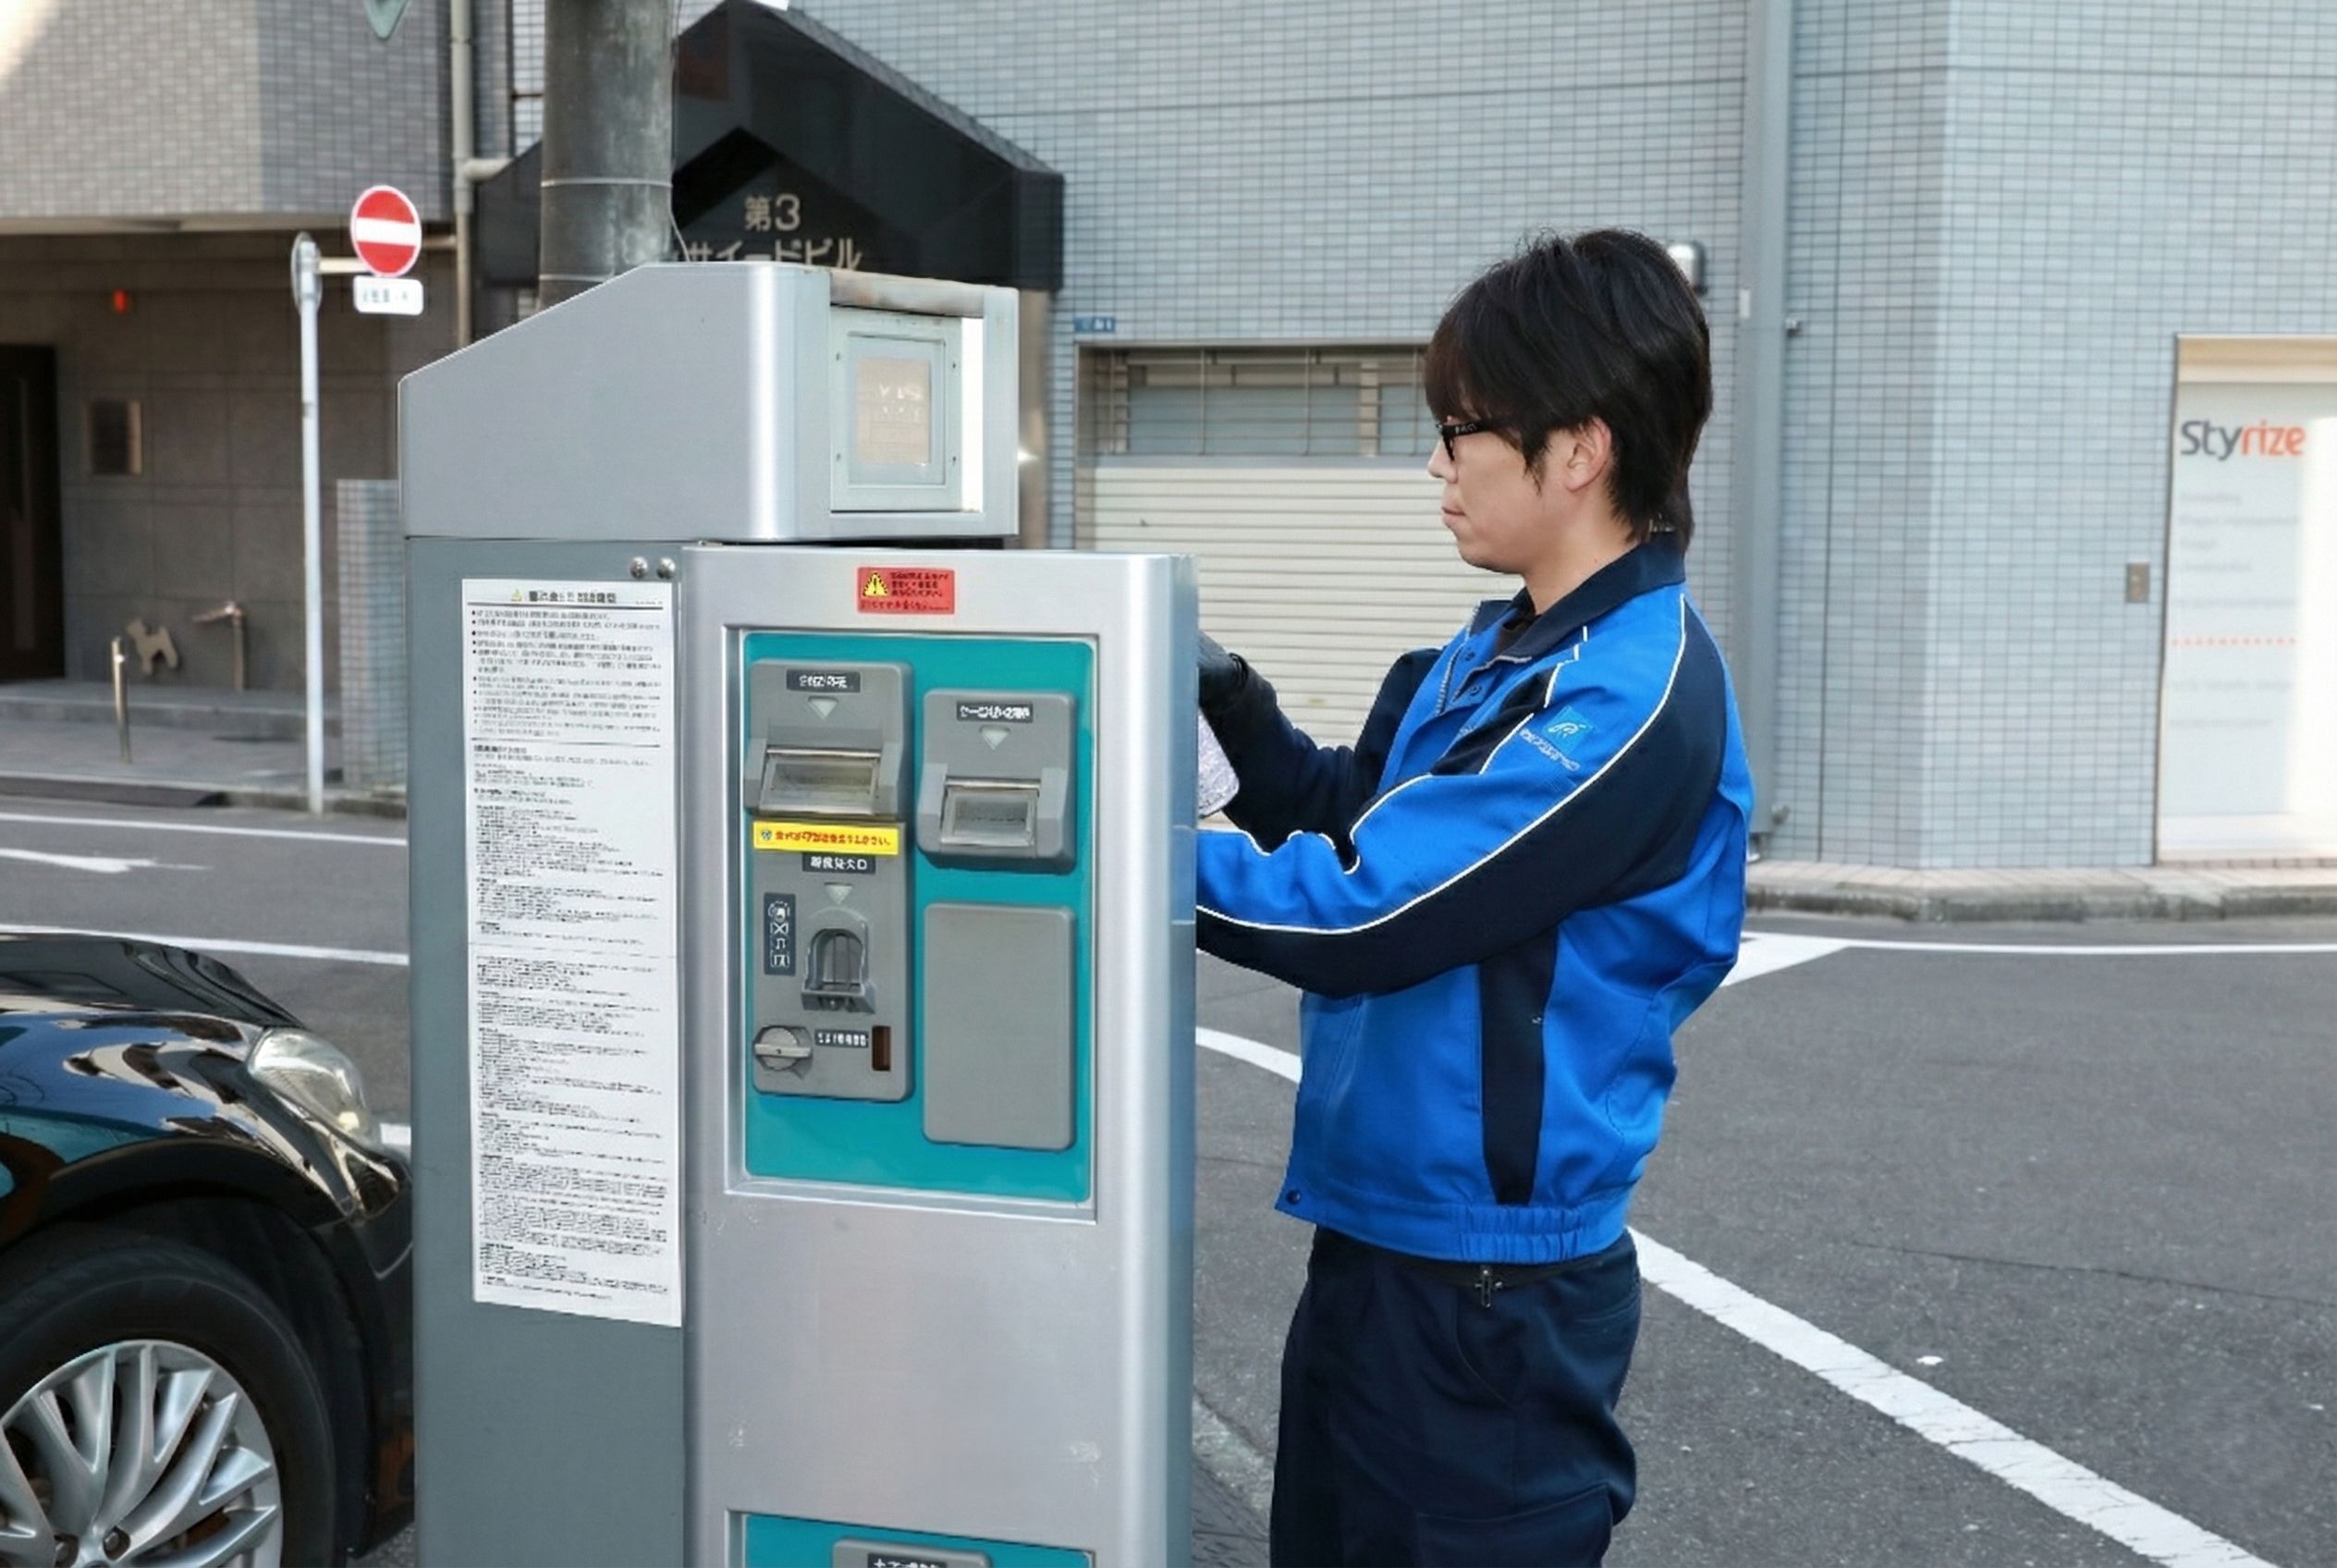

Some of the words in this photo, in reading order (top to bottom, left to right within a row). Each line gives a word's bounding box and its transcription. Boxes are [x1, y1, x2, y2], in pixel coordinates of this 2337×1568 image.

[745, 193, 801, 231] 第3
[673, 237, 863, 269] サイードビル
[2180, 419, 2306, 461] Styrize
